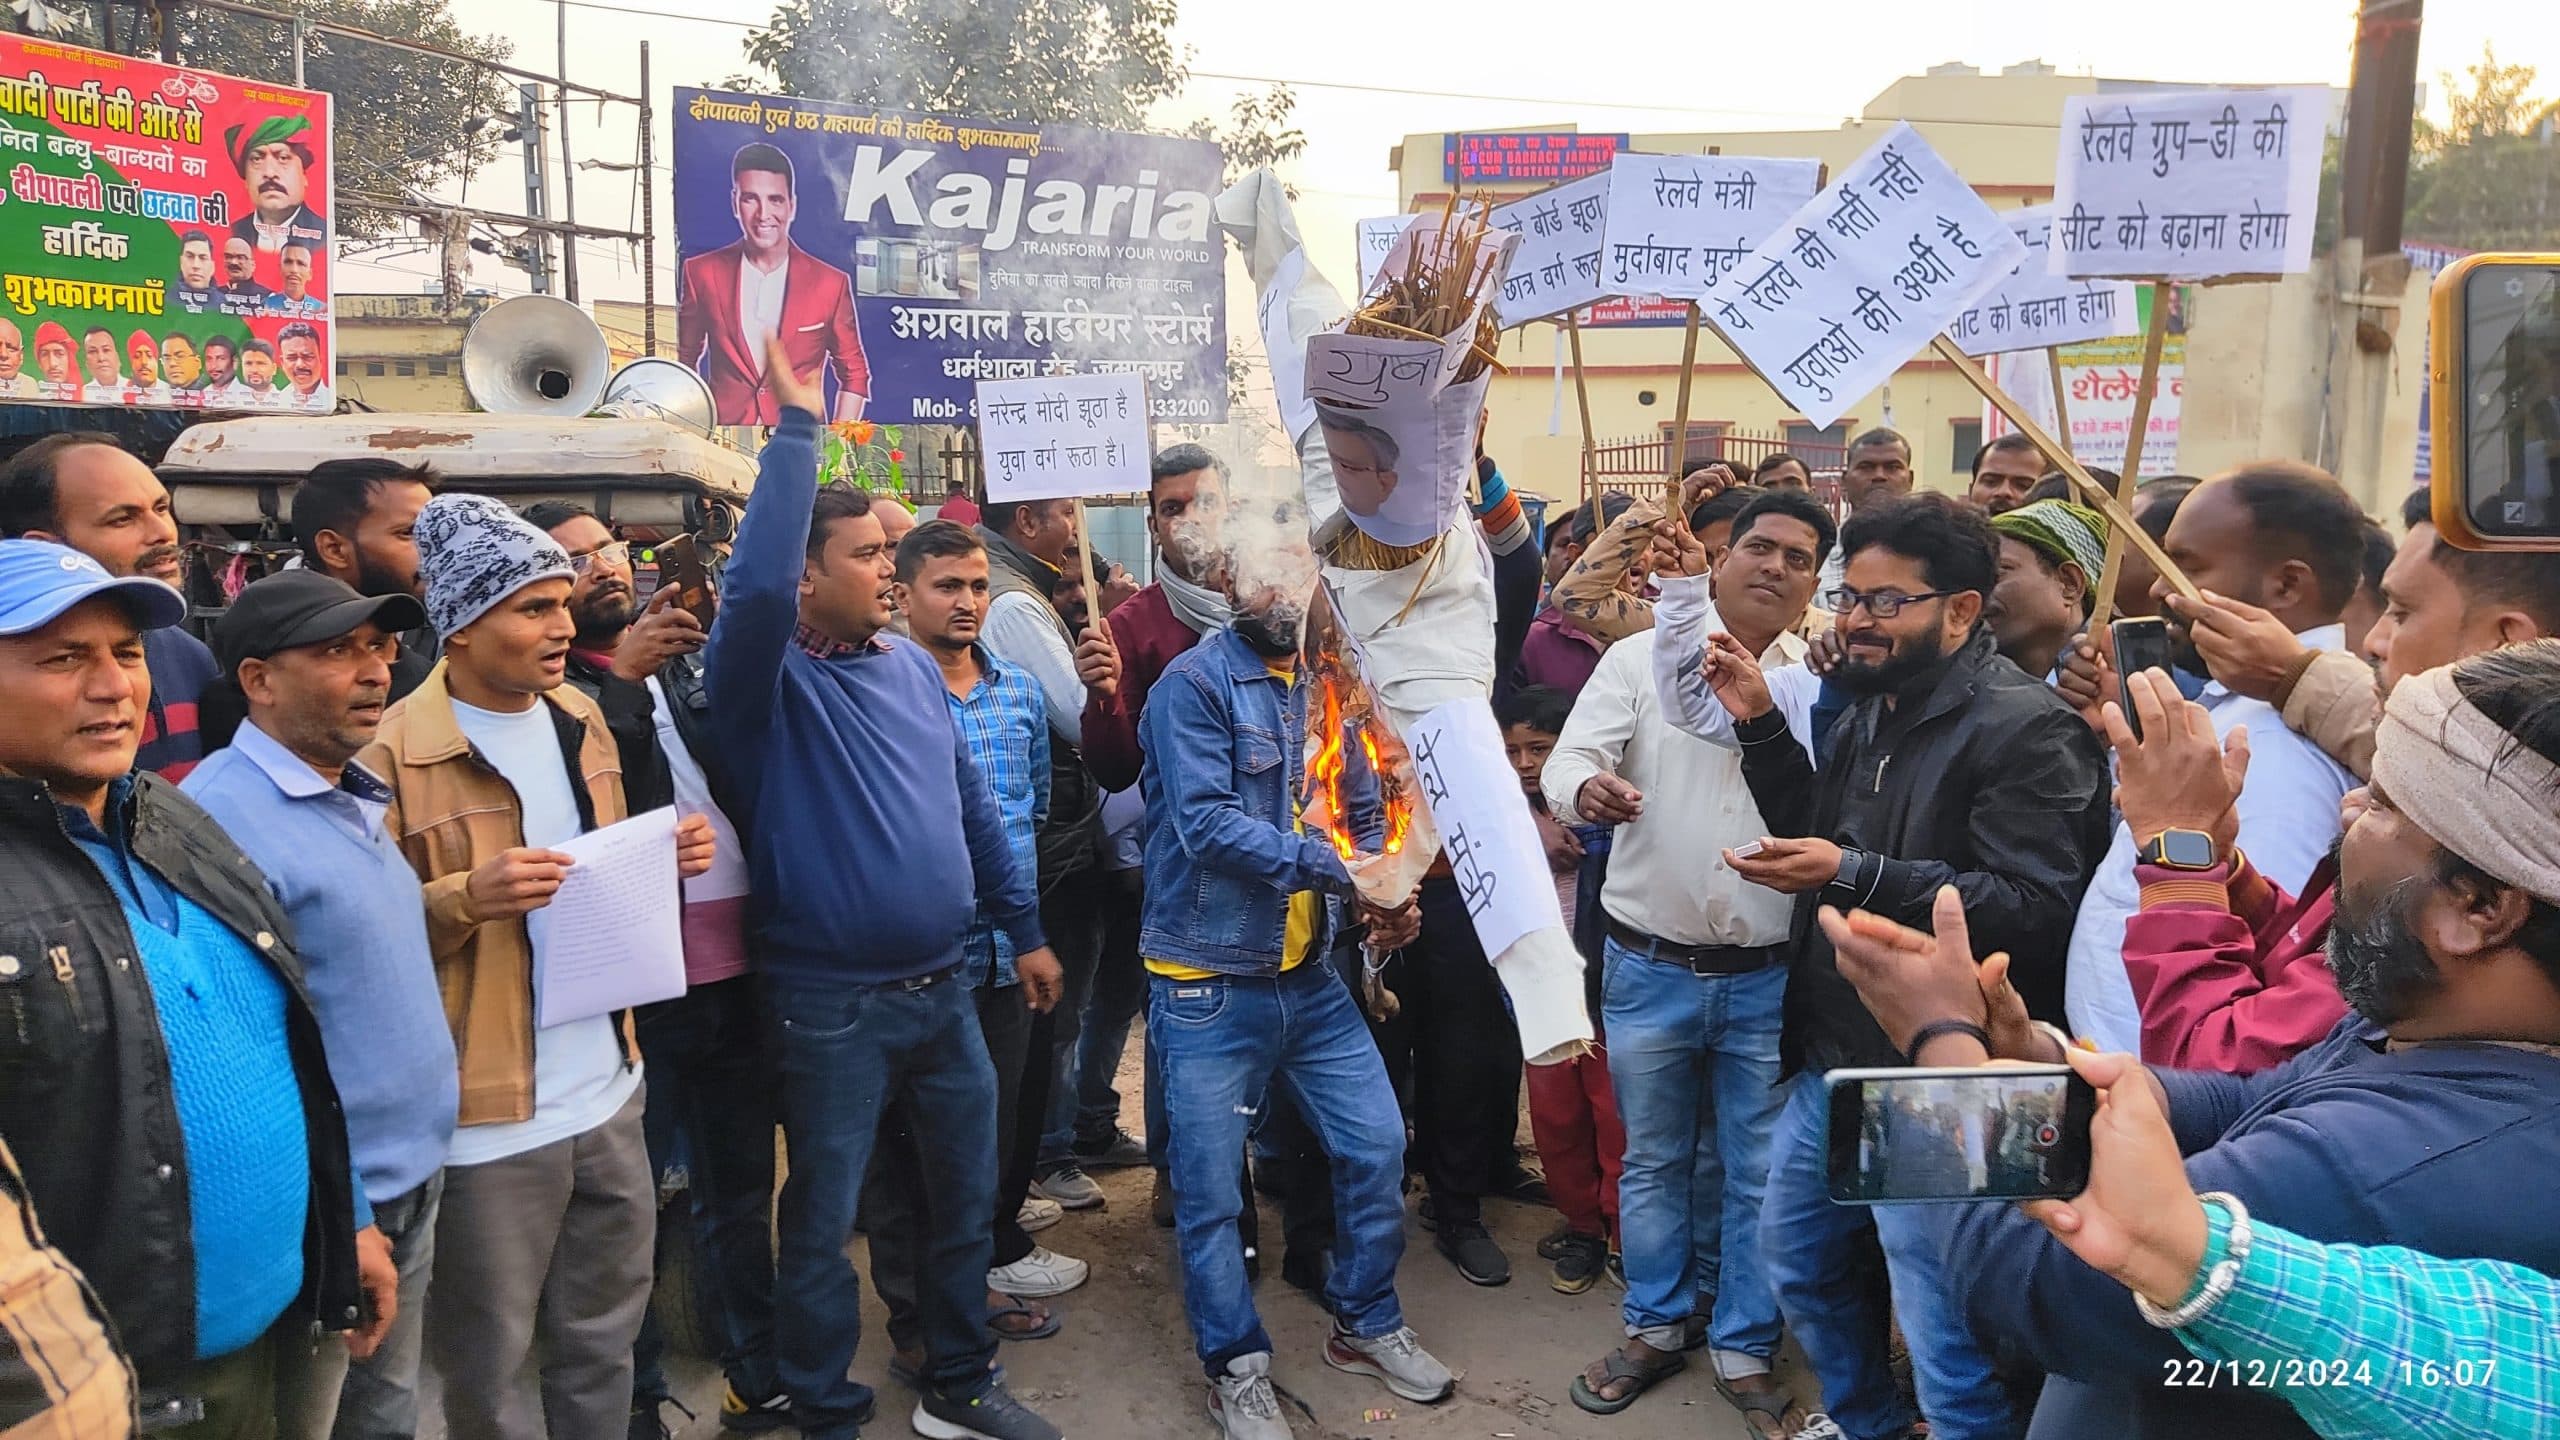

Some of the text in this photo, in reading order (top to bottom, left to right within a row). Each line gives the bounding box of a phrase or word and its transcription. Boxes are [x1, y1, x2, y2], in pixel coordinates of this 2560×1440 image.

[53, 80, 101, 128] पार्टी
[105, 88, 134, 133] की
[140, 93, 180, 140] ओर
[183, 107, 202, 144] से
[690, 96, 762, 124] दीपावली
[765, 106, 793, 134] एवं
[795, 111, 820, 129] छठ
[823, 112, 879, 135] महापर्व
[880, 115, 903, 137] की
[905, 118, 954, 144] हार्दिक
[2080, 105, 2138, 163] रेलवे
[2253, 103, 2288, 160] की
[181, 156, 207, 177] का
[1654, 167, 1757, 211] रेलवे मंत्री
[11, 163, 104, 211] दीपावली
[107, 180, 139, 215] एवं
[202, 191, 229, 226] की
[844, 145, 1210, 250] Kajaria
[1531, 198, 1563, 238] बोर्ड
[1568, 194, 1603, 234] झूठा
[42, 221, 129, 261] हार्दिक
[1021, 241, 1209, 263] TRANSFORM YOUR WORLD
[1713, 143, 1924, 331] ये रेलवे की भर्ती नहीं
[2059, 202, 2105, 252] सीट
[2117, 200, 2149, 252] को
[2161, 213, 2228, 258] बढ़ाना
[2239, 198, 2291, 251] होगा
[989, 267, 1020, 290] दुनिया
[1025, 271, 1038, 287] का
[1043, 270, 1068, 288] सबसे
[1106, 272, 1132, 291] बिकने
[1136, 277, 1159, 292] वाला
[1503, 272, 1537, 302] छात्र
[1540, 252, 1567, 290] वर्ग
[1614, 233, 1692, 284] मुर्दाबाद
[1851, 285, 1903, 335] की
[1893, 233, 1956, 302] अर्थी
[1936, 214, 1982, 259] है
[890, 298, 1215, 347] अग्रवाल हार्डवेयर स्टोर्स
[1596, 309, 1687, 320] RAILWAY PROTECTION
[1989, 293, 2011, 334] को
[2076, 282, 2116, 324] होगा
[942, 350, 1037, 380] धर्मशाला
[988, 388, 1128, 429] नरेन्द्र मोदी झूठा है
[998, 450, 1026, 482] युवा
[1033, 439, 1057, 471] वर्ग
[1066, 446, 1098, 469] रूठा
[1415, 728, 1497, 919] रेल मंत्री
